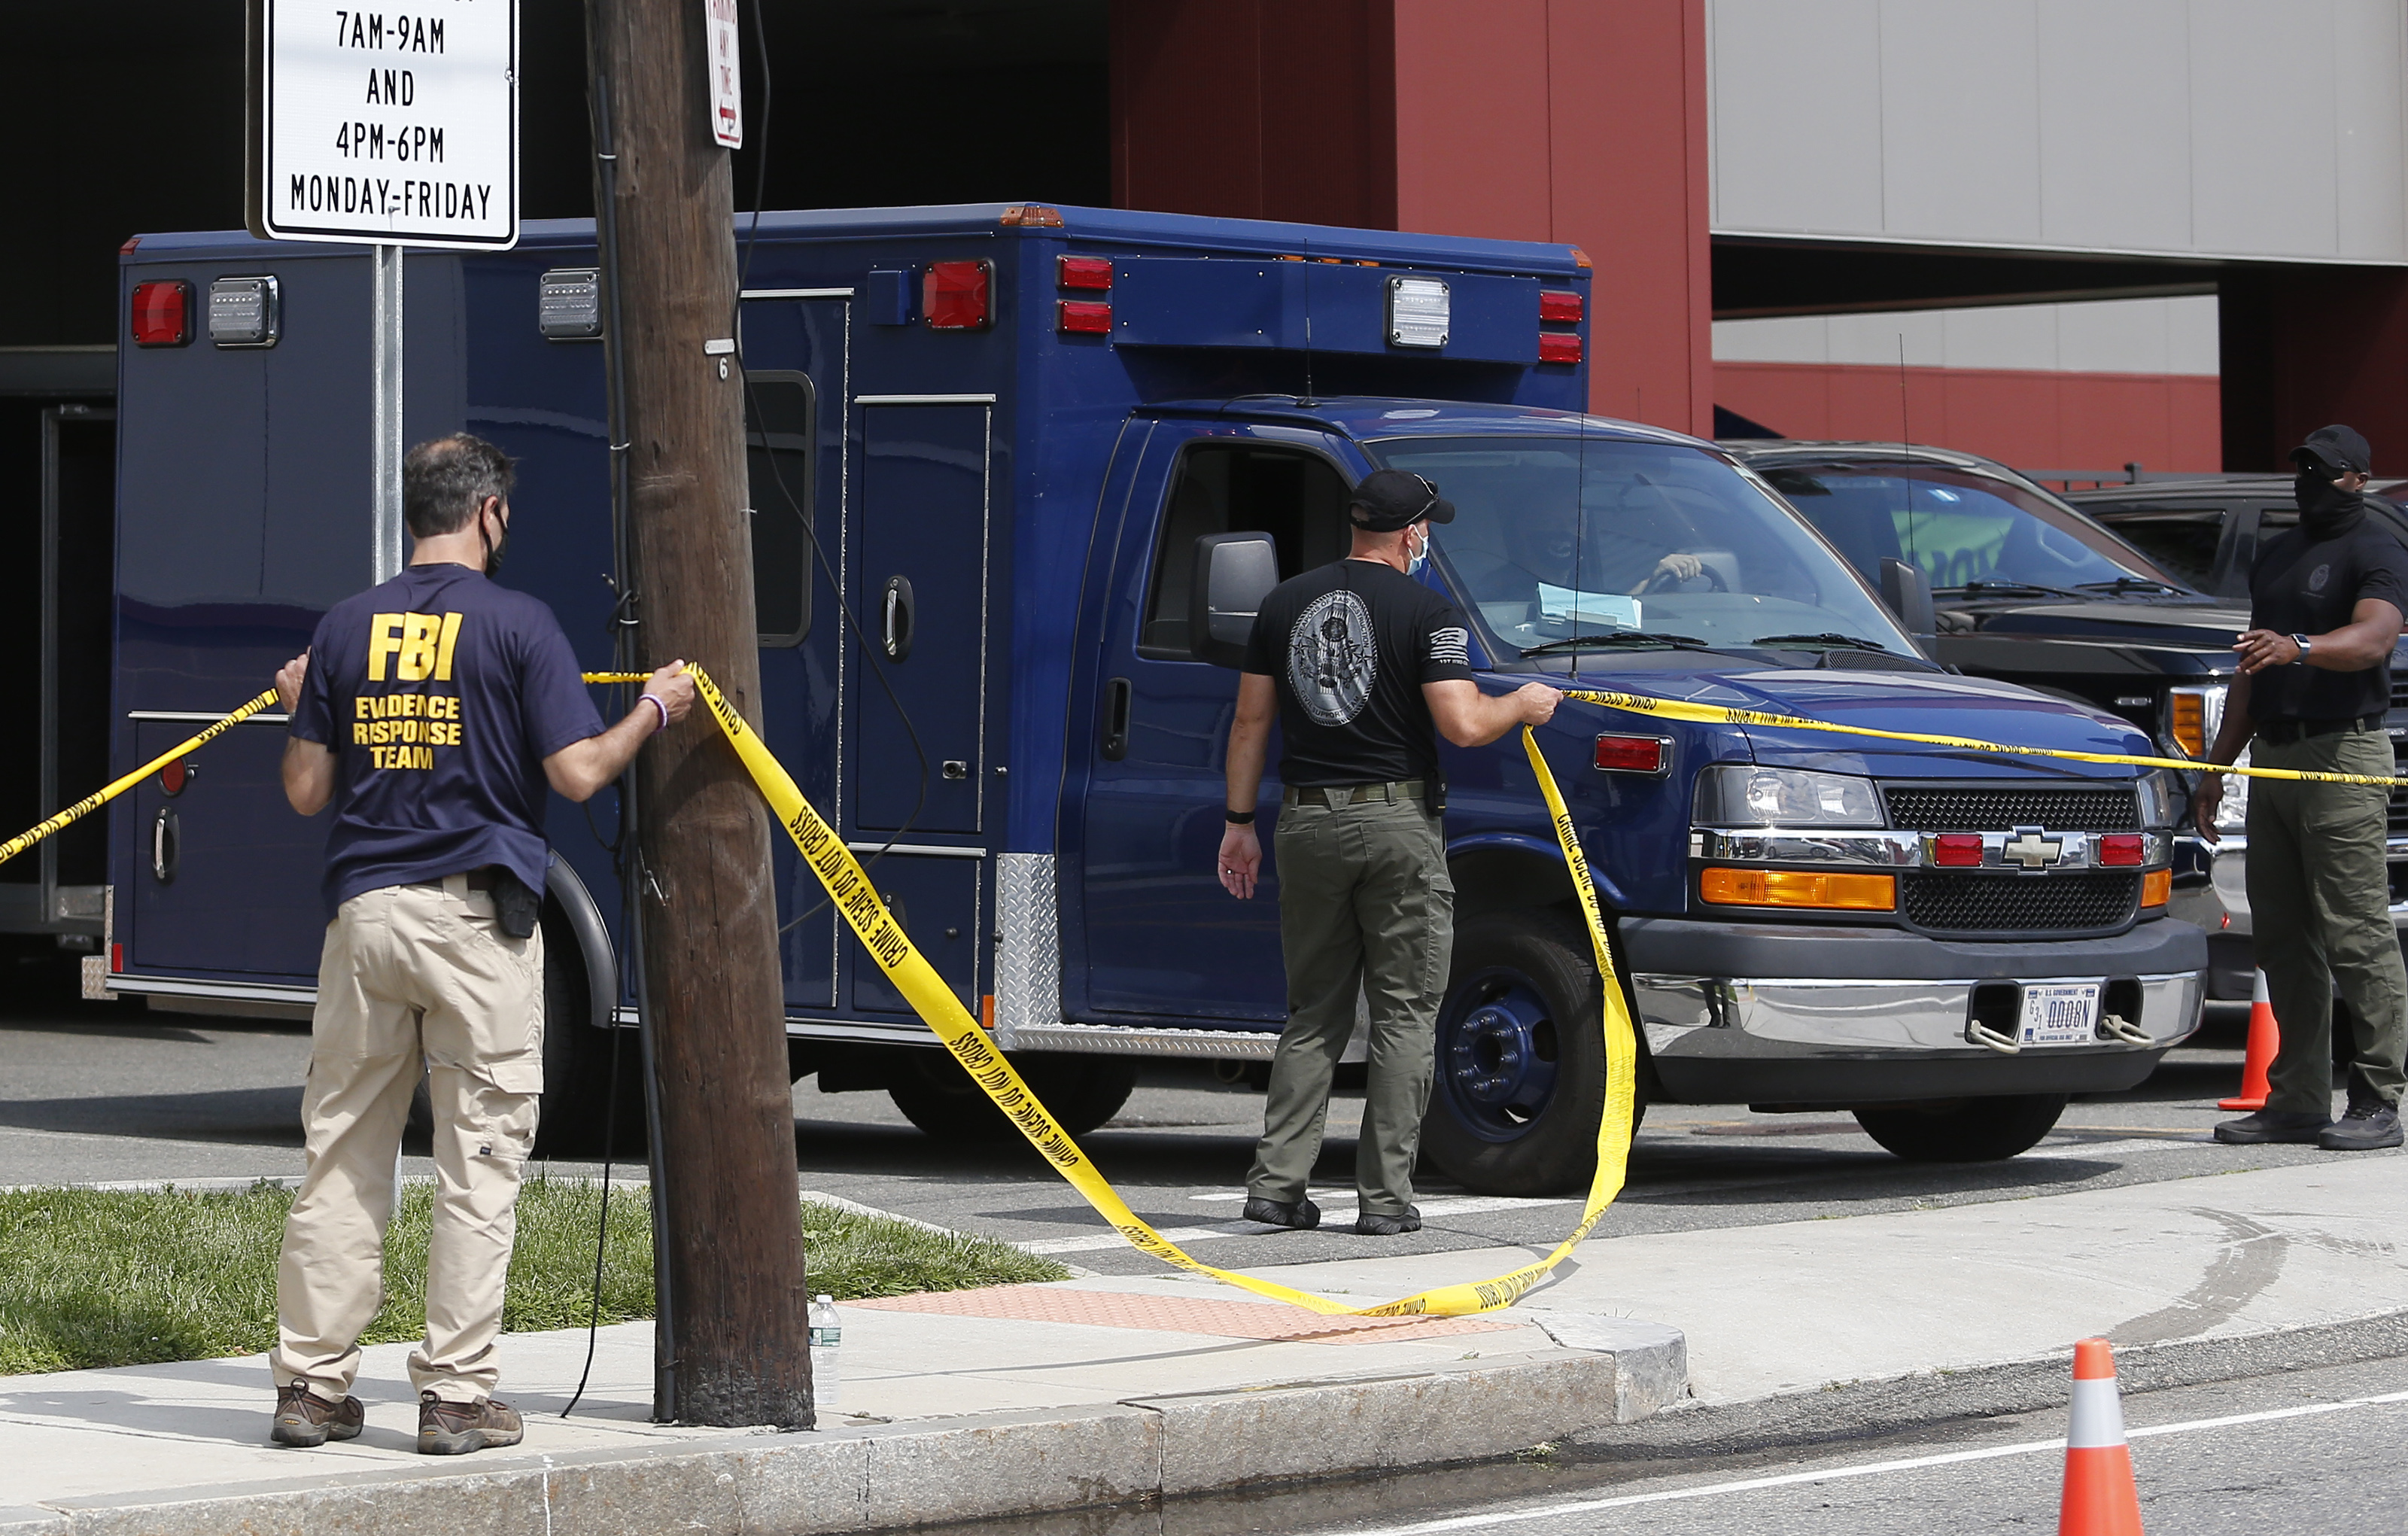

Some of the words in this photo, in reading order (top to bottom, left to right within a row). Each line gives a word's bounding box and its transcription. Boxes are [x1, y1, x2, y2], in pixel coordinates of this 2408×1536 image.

[336, 11, 444, 54] 7AM-9AM
[366, 68, 415, 107] AND
[336, 121, 444, 163] 4PM-6PM
[291, 174, 491, 221] MONDAY-FRIDAY
[719, 357, 728, 379] 6
[1297, 604, 1321, 638] WEAPONS
[1321, 598, 1330, 607] OF
[1349, 601, 1370, 649] DESTRUCTION
[367, 611, 464, 681] FBI
[355, 693, 462, 719] EVIDENCE
[1300, 689, 1314, 709] CIVIL
[1311, 706, 1345, 719] SUPPORT
[1343, 695, 1361, 713] TEAM
[352, 719, 463, 746] RESPONSE
[369, 745, 434, 771] TEAM
[788, 804, 830, 856] CROSS
[814, 844, 847, 881] NOT
[831, 868, 859, 899] DO
[843, 886, 880, 933] SCENE
[868, 919, 908, 969] CRIME
[948, 1030, 995, 1073] CROSS
[975, 1065, 1012, 1093] NOT
[995, 1084, 1025, 1110] DO
[1008, 1101, 1052, 1142] SCENE
[1036, 1132, 1079, 1170] CRIME
